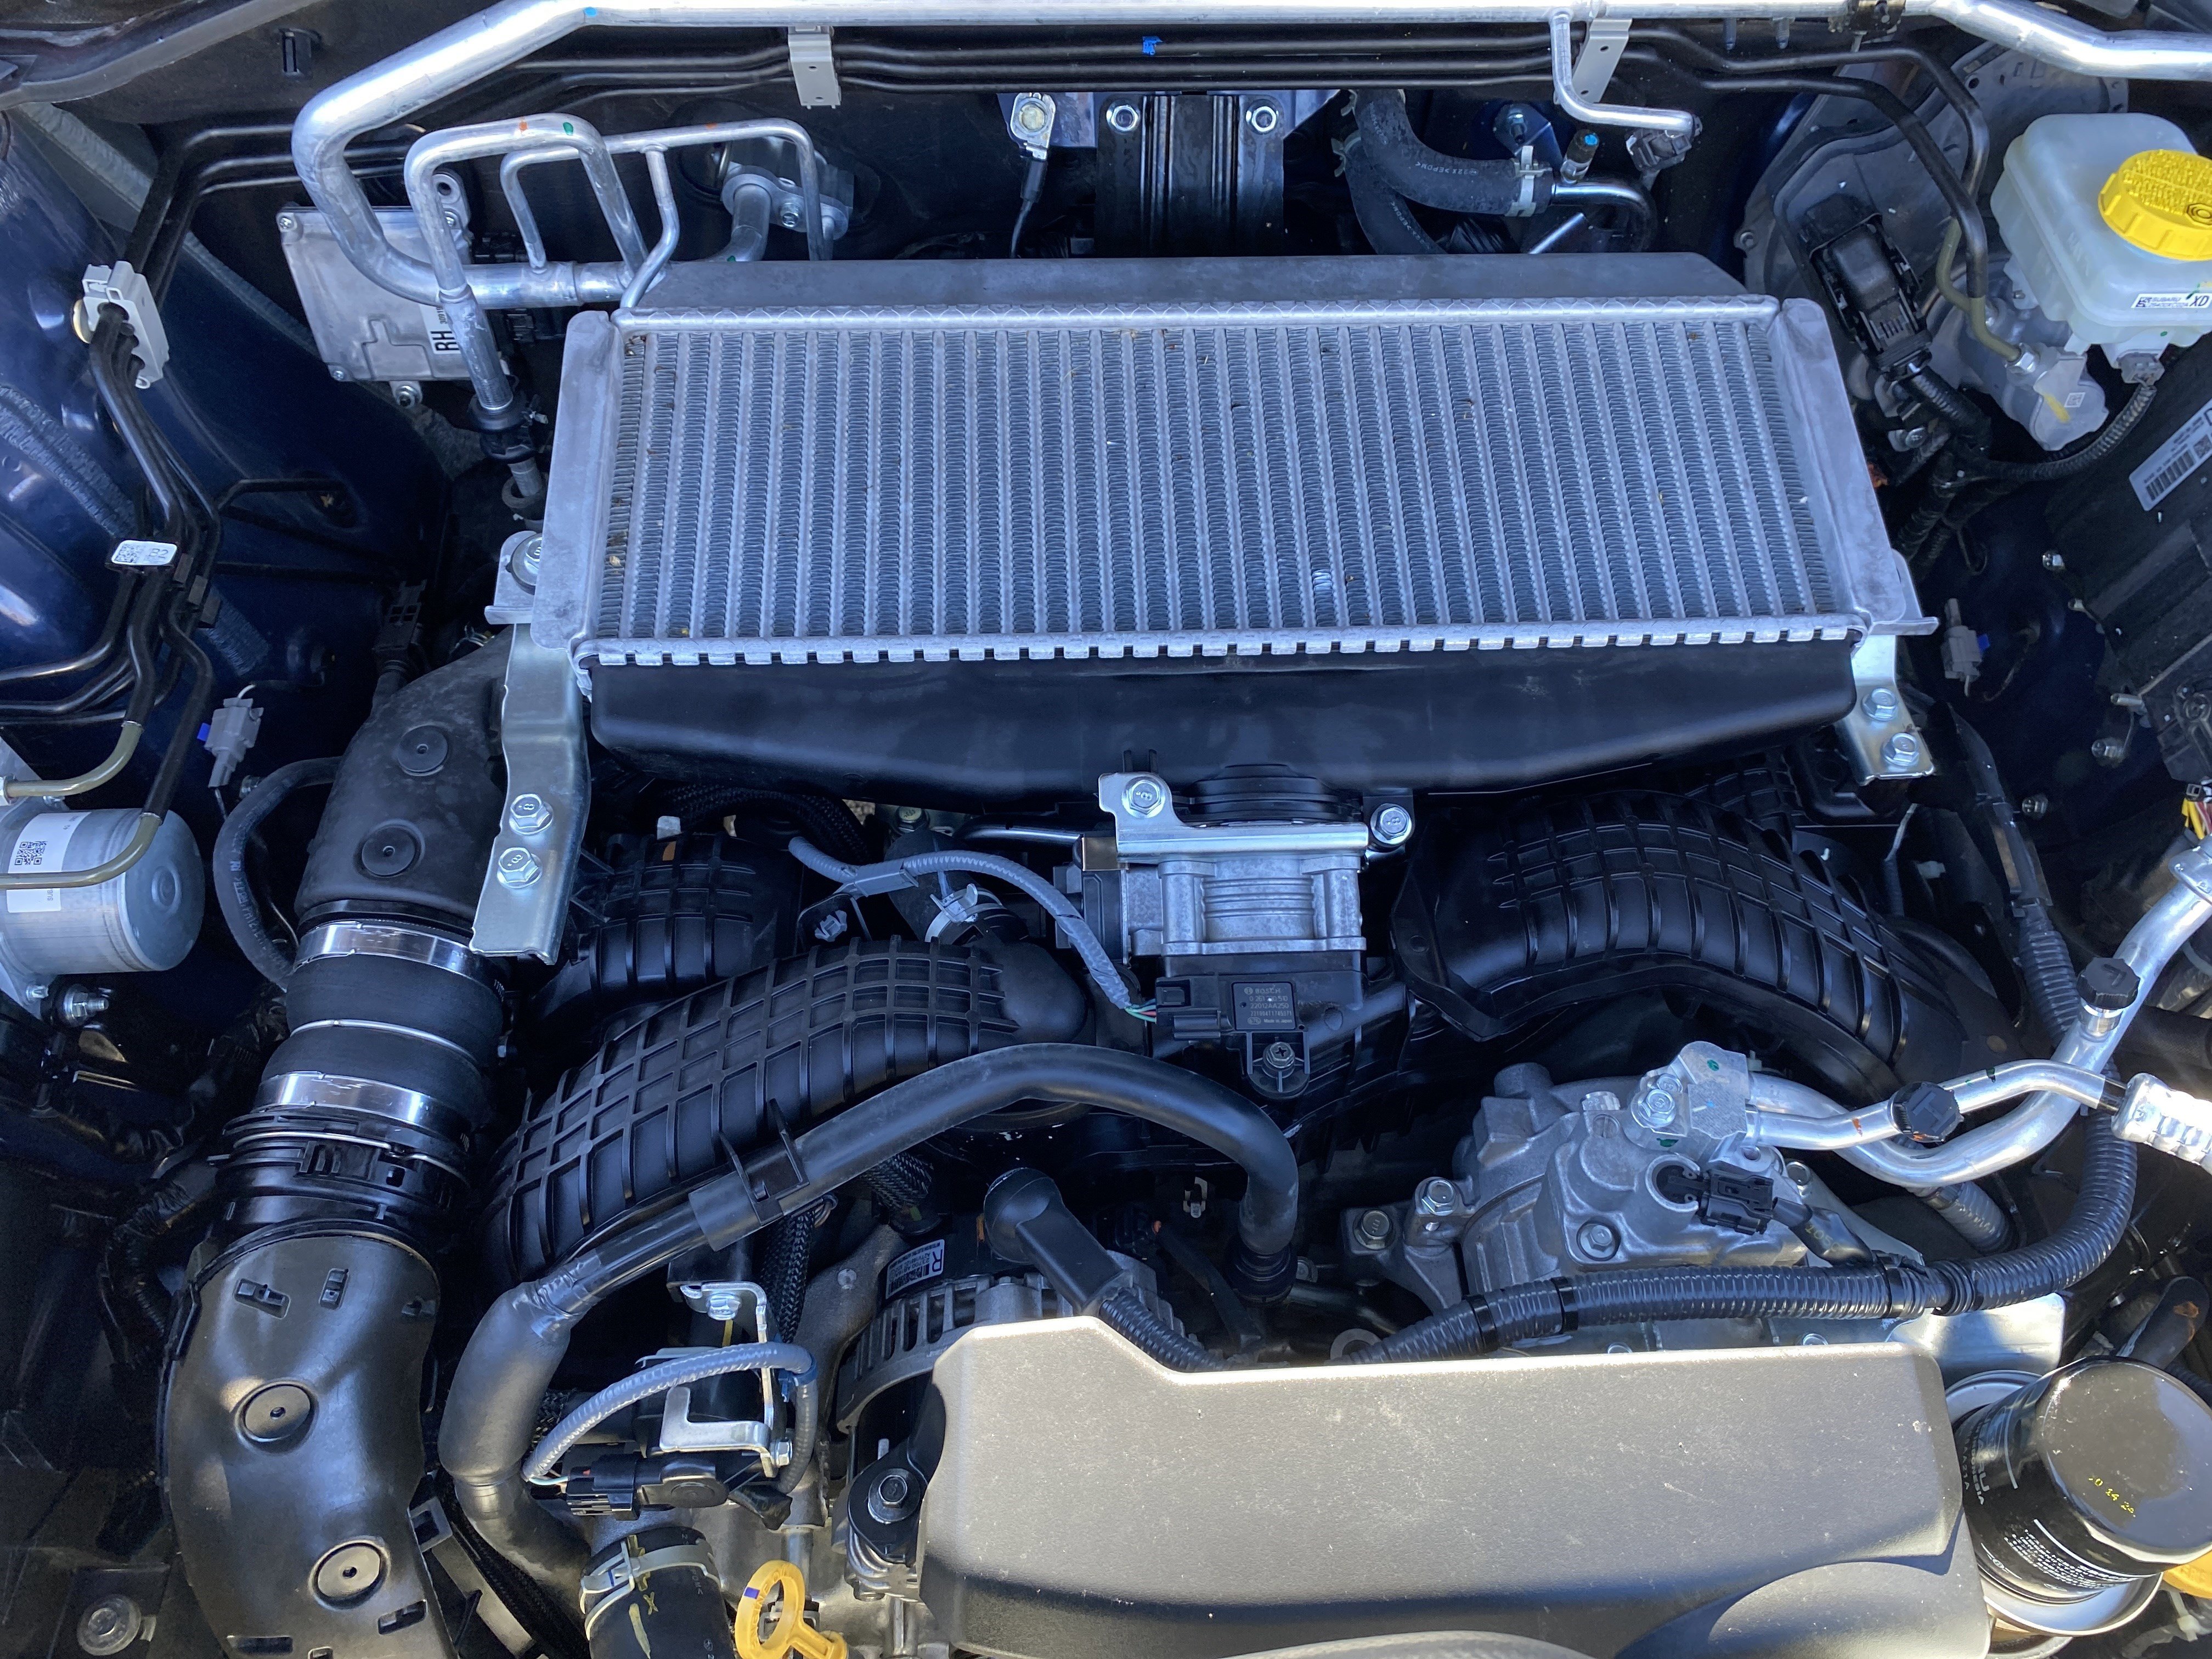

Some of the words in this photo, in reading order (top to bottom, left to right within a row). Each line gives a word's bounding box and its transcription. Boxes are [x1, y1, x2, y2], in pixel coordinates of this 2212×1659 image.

[2189, 295, 2210, 307] XD
[430, 331, 460, 351] RH
[148, 548, 169, 558] B2
[1912, 1092, 1956, 1133] H
[932, 1249, 943, 1273] R
